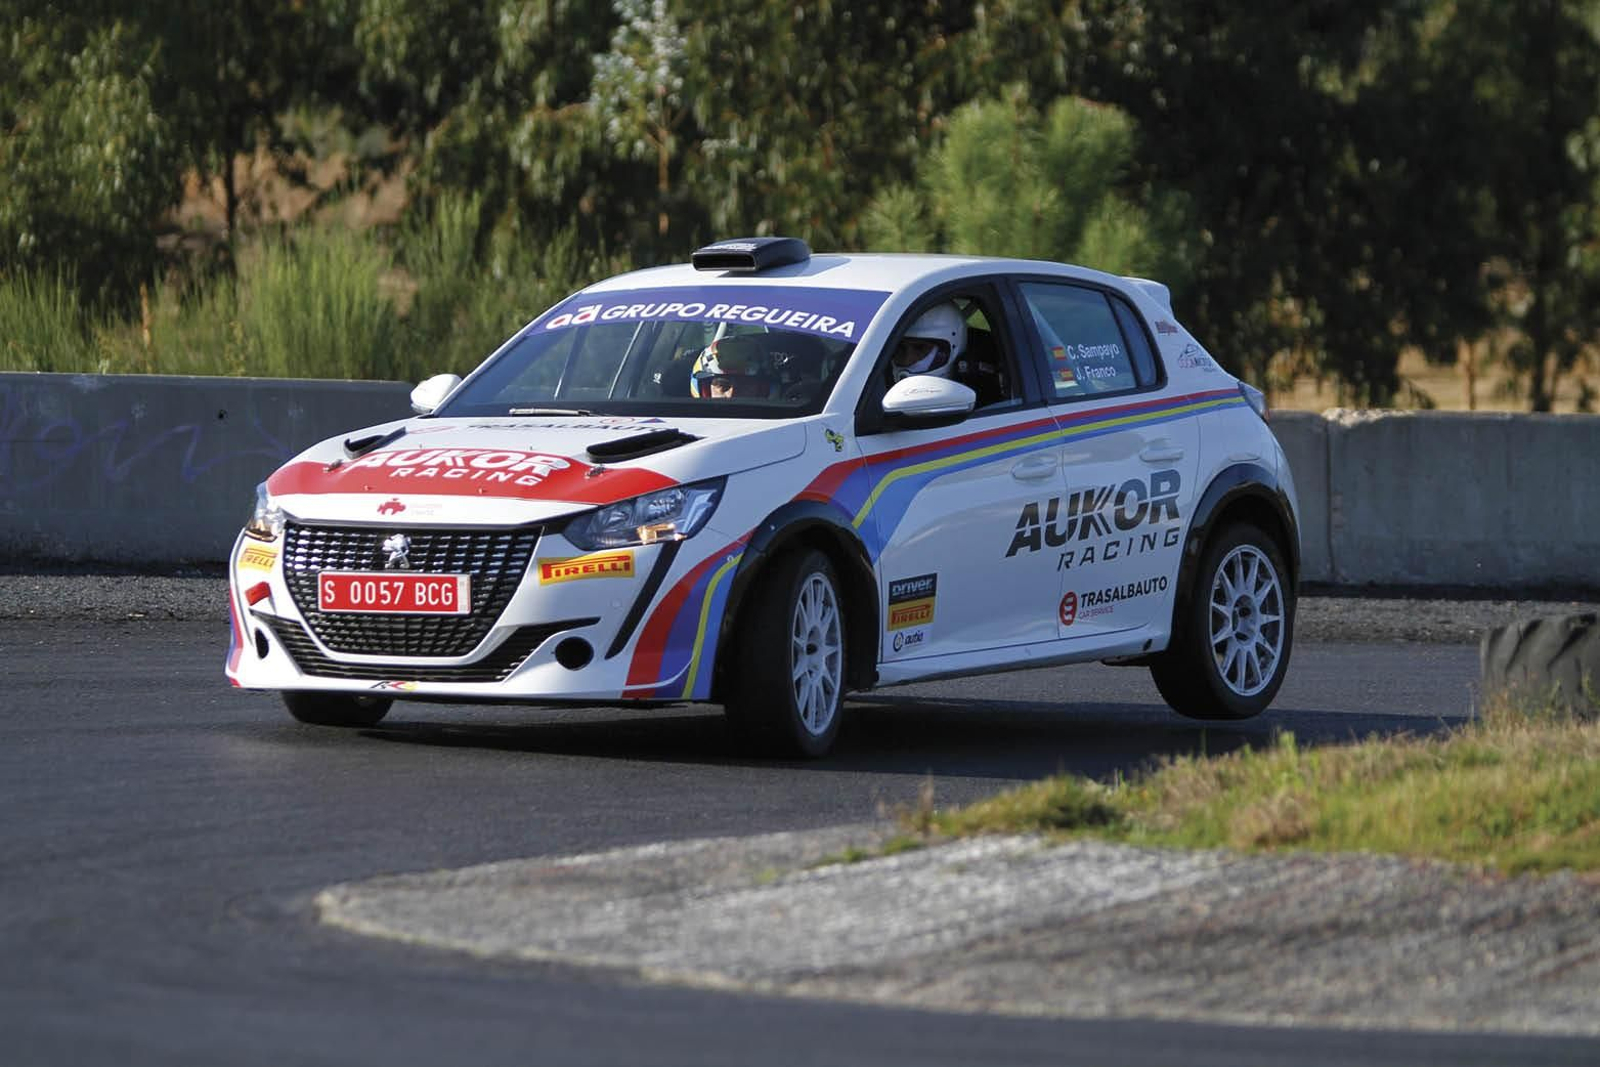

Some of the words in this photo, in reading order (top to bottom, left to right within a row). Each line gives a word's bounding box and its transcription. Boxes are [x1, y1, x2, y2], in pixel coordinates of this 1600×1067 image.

[601, 302, 706, 320] GRUPO
[704, 303, 856, 338] REGUEIRA
[1078, 343, 1120, 360] Sampayo
[1084, 365, 1116, 378] Franco
[340, 449, 571, 477] AUKOR
[389, 468, 544, 486] RACING
[1005, 469, 1182, 558] AUKOR
[1057, 526, 1180, 572] RACING
[541, 555, 631, 579] PIRELLI
[324, 580, 336, 604] S
[350, 581, 405, 605] 0057
[415, 582, 453, 606] BCG
[1080, 576, 1168, 608] TRASALBAUTO
